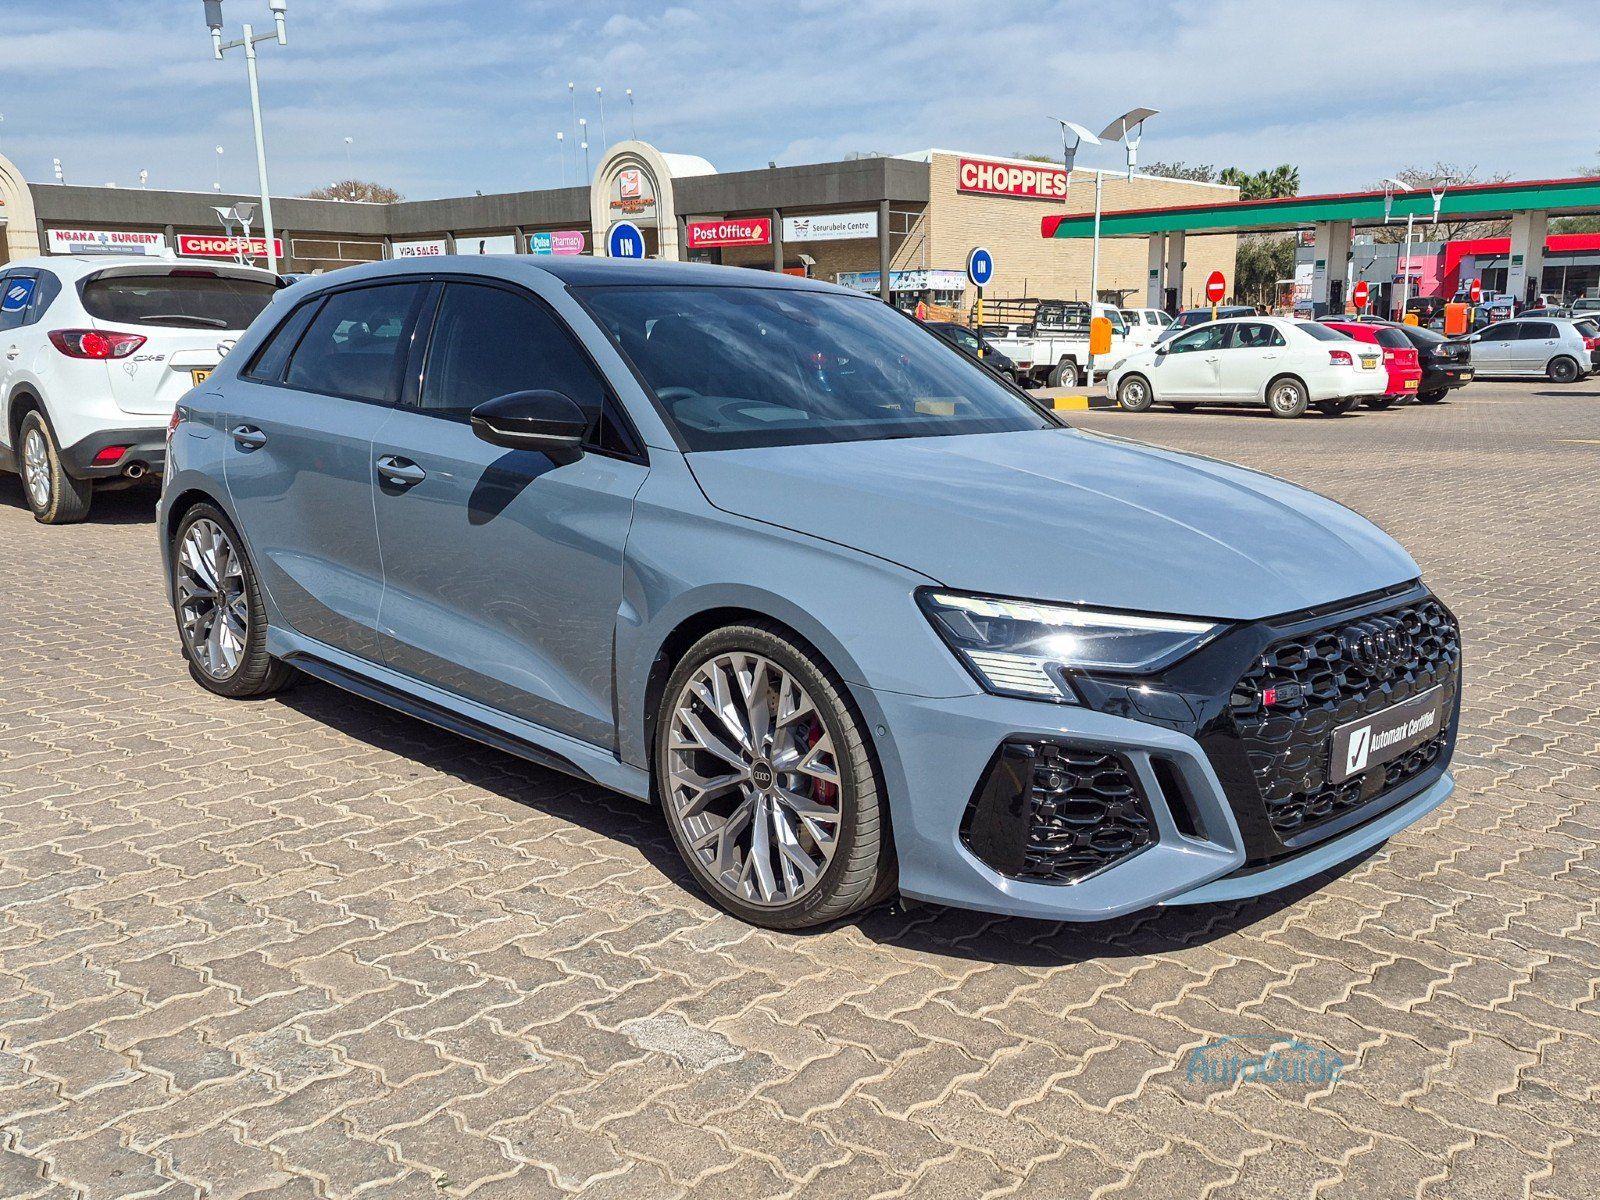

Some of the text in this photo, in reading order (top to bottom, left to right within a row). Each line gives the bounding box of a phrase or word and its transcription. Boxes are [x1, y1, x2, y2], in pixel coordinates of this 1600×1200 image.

[961, 163, 1067, 196] CHOPPIES
[693, 224, 751, 240] Post Office
[847, 222, 869, 230] Centre
[56, 231, 158, 243] NGAKA SURGERY
[533, 236, 580, 249] Pulse Pharmacy
[416, 245, 439, 255] SALES
[620, 238, 633, 256] IN
[977, 260, 986, 273] IN
[1370, 708, 1436, 753] Automark Certified
